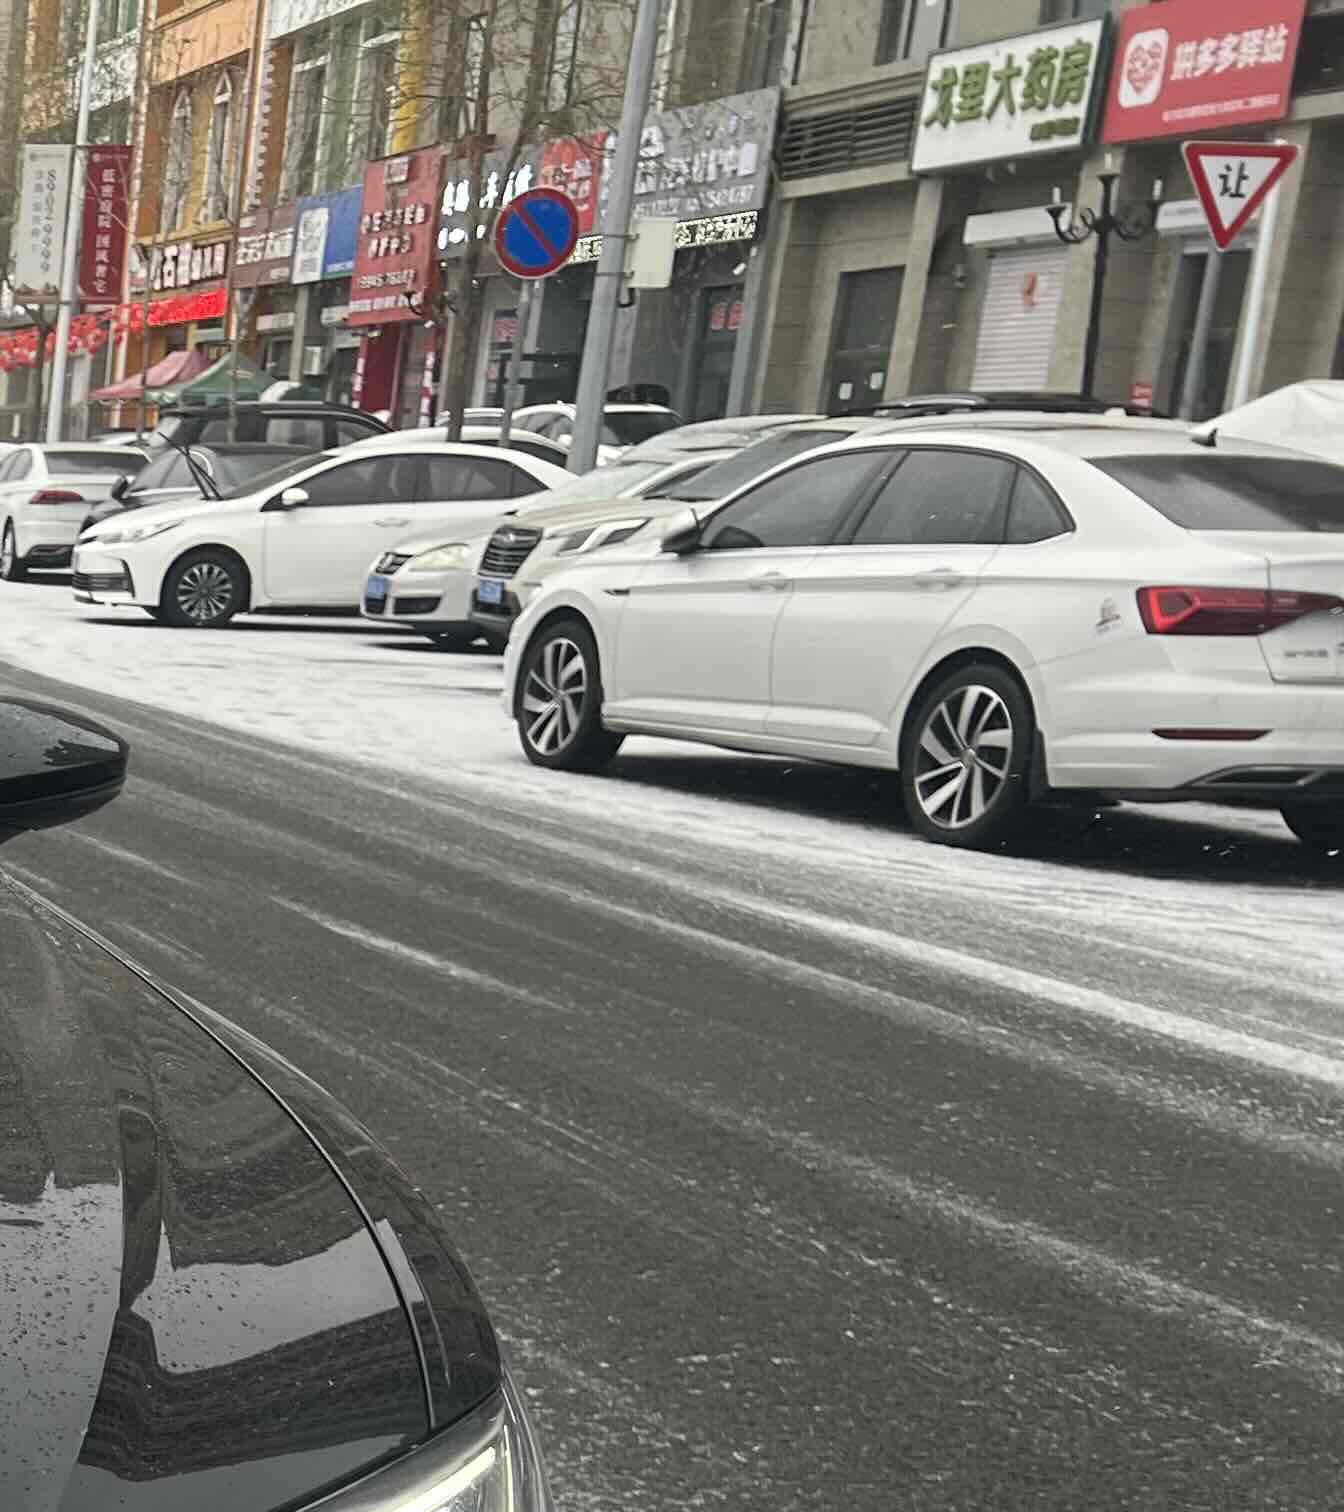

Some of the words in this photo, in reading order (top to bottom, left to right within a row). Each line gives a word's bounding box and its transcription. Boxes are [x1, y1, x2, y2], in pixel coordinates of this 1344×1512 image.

[1170, 23, 1289, 80] 拼多多驿站
[1218, 165, 1250, 200] 让
